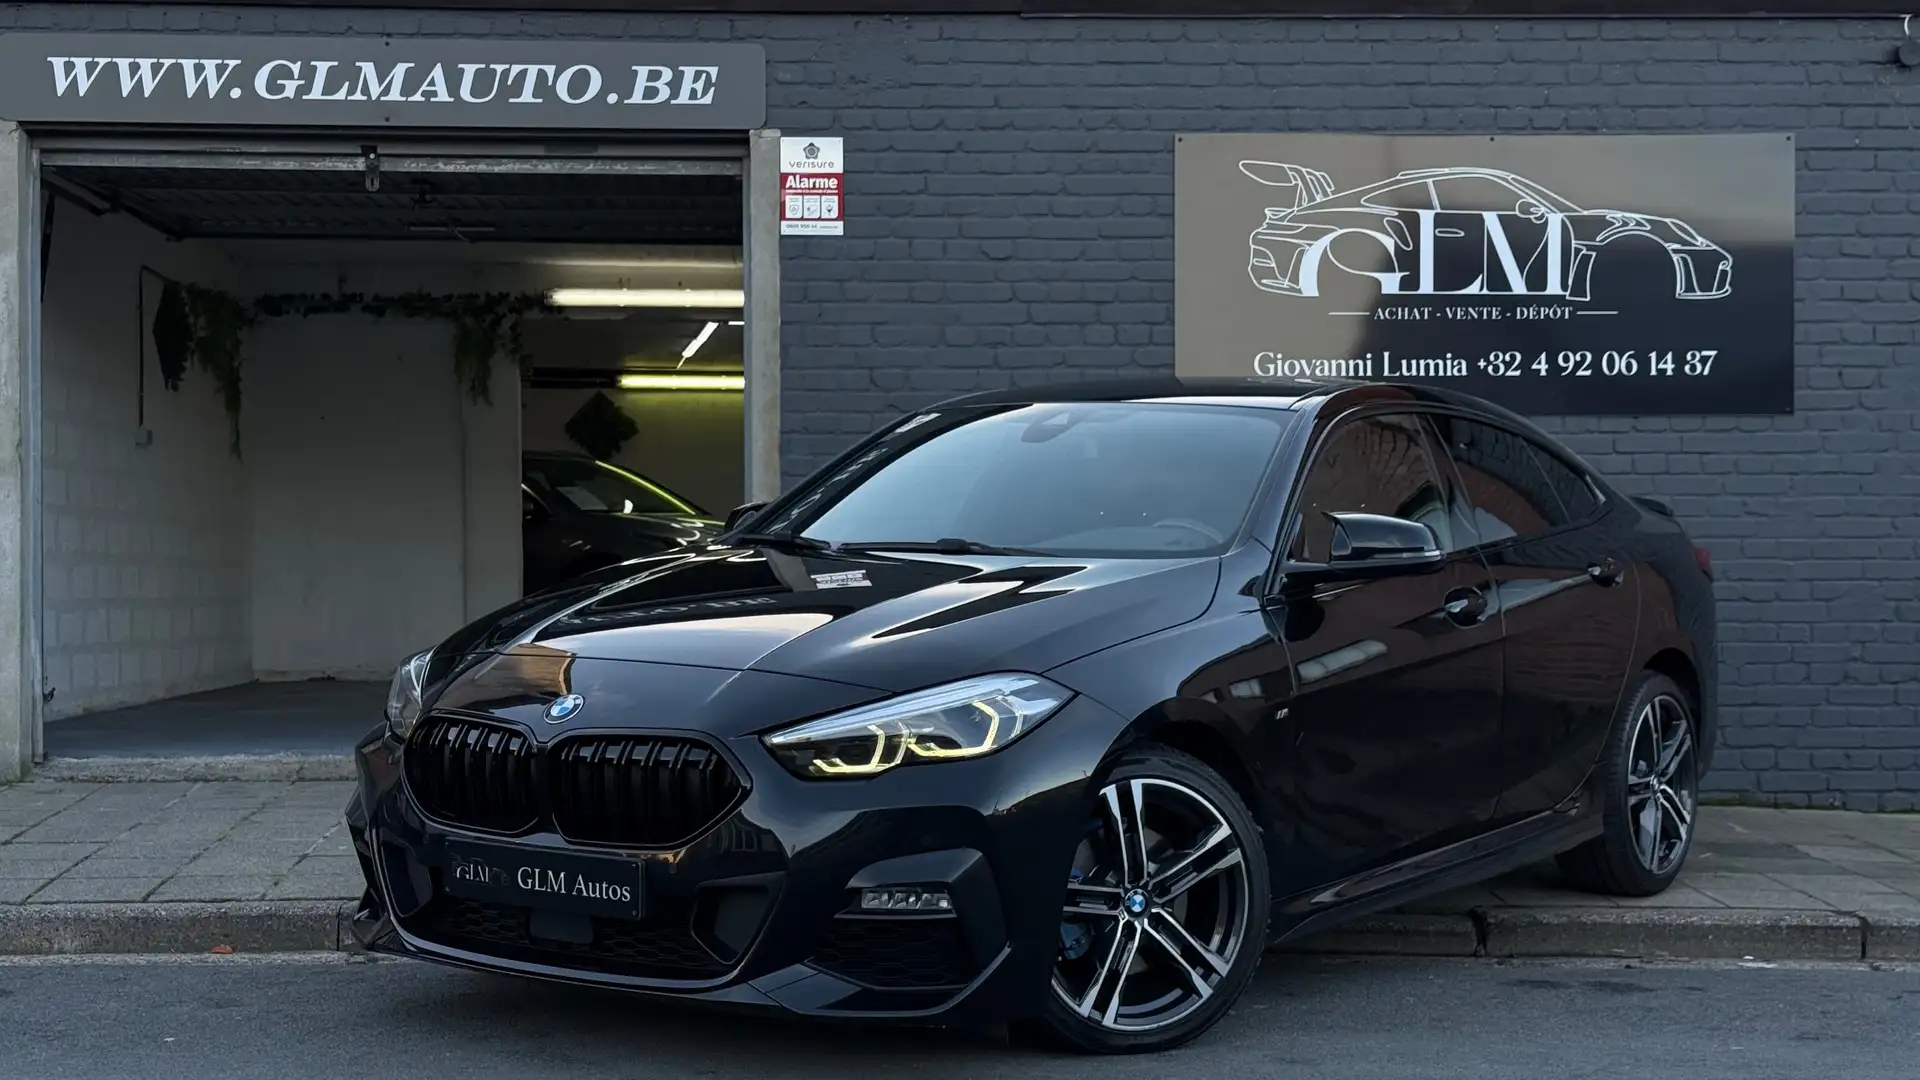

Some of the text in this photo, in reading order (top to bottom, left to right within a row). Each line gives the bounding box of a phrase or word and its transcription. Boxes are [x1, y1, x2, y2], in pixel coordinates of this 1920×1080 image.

[47, 56, 719, 105] WWW.GLMAUTO.BE
[789, 161, 834, 169] verisure
[785, 174, 838, 189] Alarme
[1299, 209, 1569, 297] GLM
[1374, 307, 1432, 320] ACHAT
[1445, 307, 1502, 320] VENTE
[1253, 351, 1718, 377] Giovanni Lumia +32 4 92 06 14 37
[517, 866, 631, 902] GLM Autos
